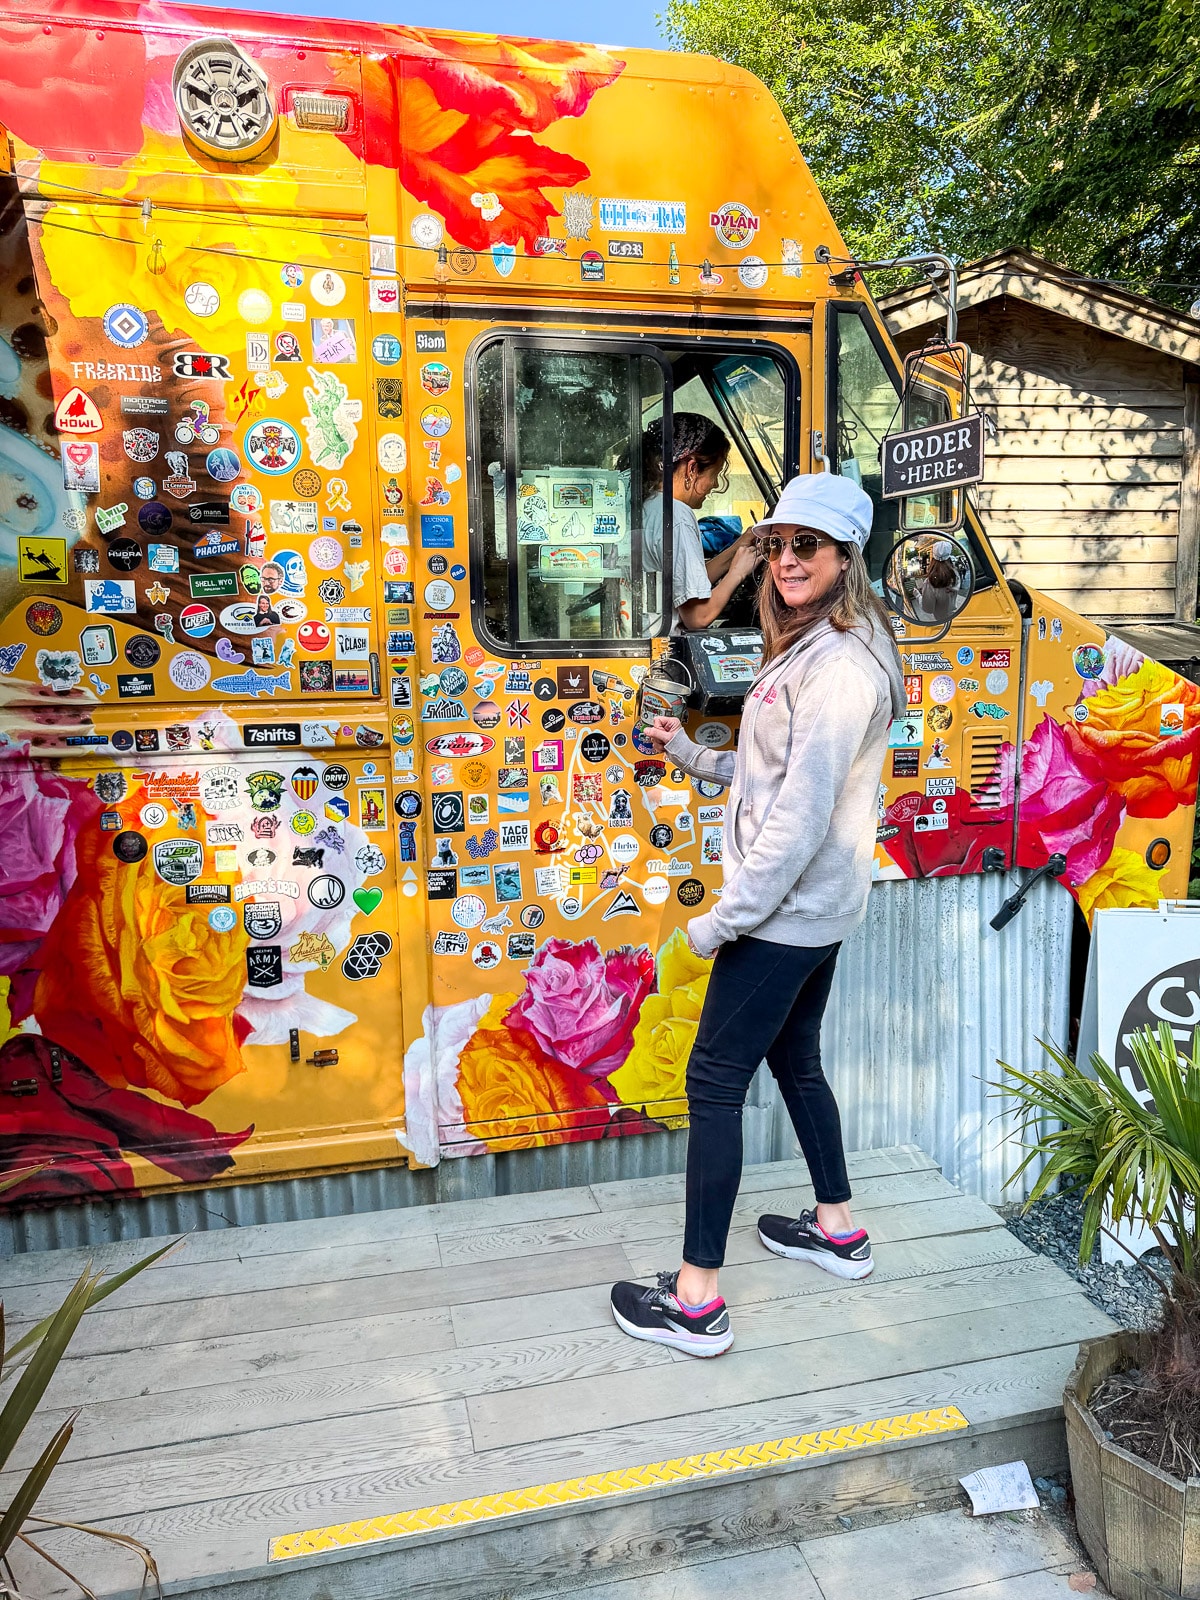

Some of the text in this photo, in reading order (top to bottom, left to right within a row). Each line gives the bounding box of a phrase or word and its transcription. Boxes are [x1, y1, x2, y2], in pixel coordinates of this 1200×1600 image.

[710, 213, 759, 231] DYLAN
[416, 334, 446, 350] Siam
[69, 361, 163, 383] FREERIDE
[59, 418, 98, 429] HOWL
[892, 427, 973, 465] ORDER
[907, 458, 957, 485] HERE
[106, 502, 128, 515] WILD
[595, 515, 616, 525] TOO
[196, 541, 238, 557] PHACTORY
[218, 578, 233, 586] WYO
[390, 631, 413, 642] TOO
[344, 636, 367, 651] CLASH
[387, 641, 416, 652] EASY
[901, 651, 944, 665] MUTUAL
[912, 661, 954, 672] TRAUMA
[508, 671, 529, 681] TOO
[505, 680, 532, 691] EASY
[248, 729, 296, 742] 7shifts
[132, 772, 200, 787] Unlimited
[324, 773, 348, 782] DRIVE
[928, 778, 954, 787] LUCA
[928, 787, 954, 796] XAVI
[699, 808, 724, 820] RADIX
[502, 835, 528, 846] MORY
[647, 858, 692, 872] Maclean
[189, 885, 228, 898] CELEBRATION
[249, 954, 280, 966] ARMY
